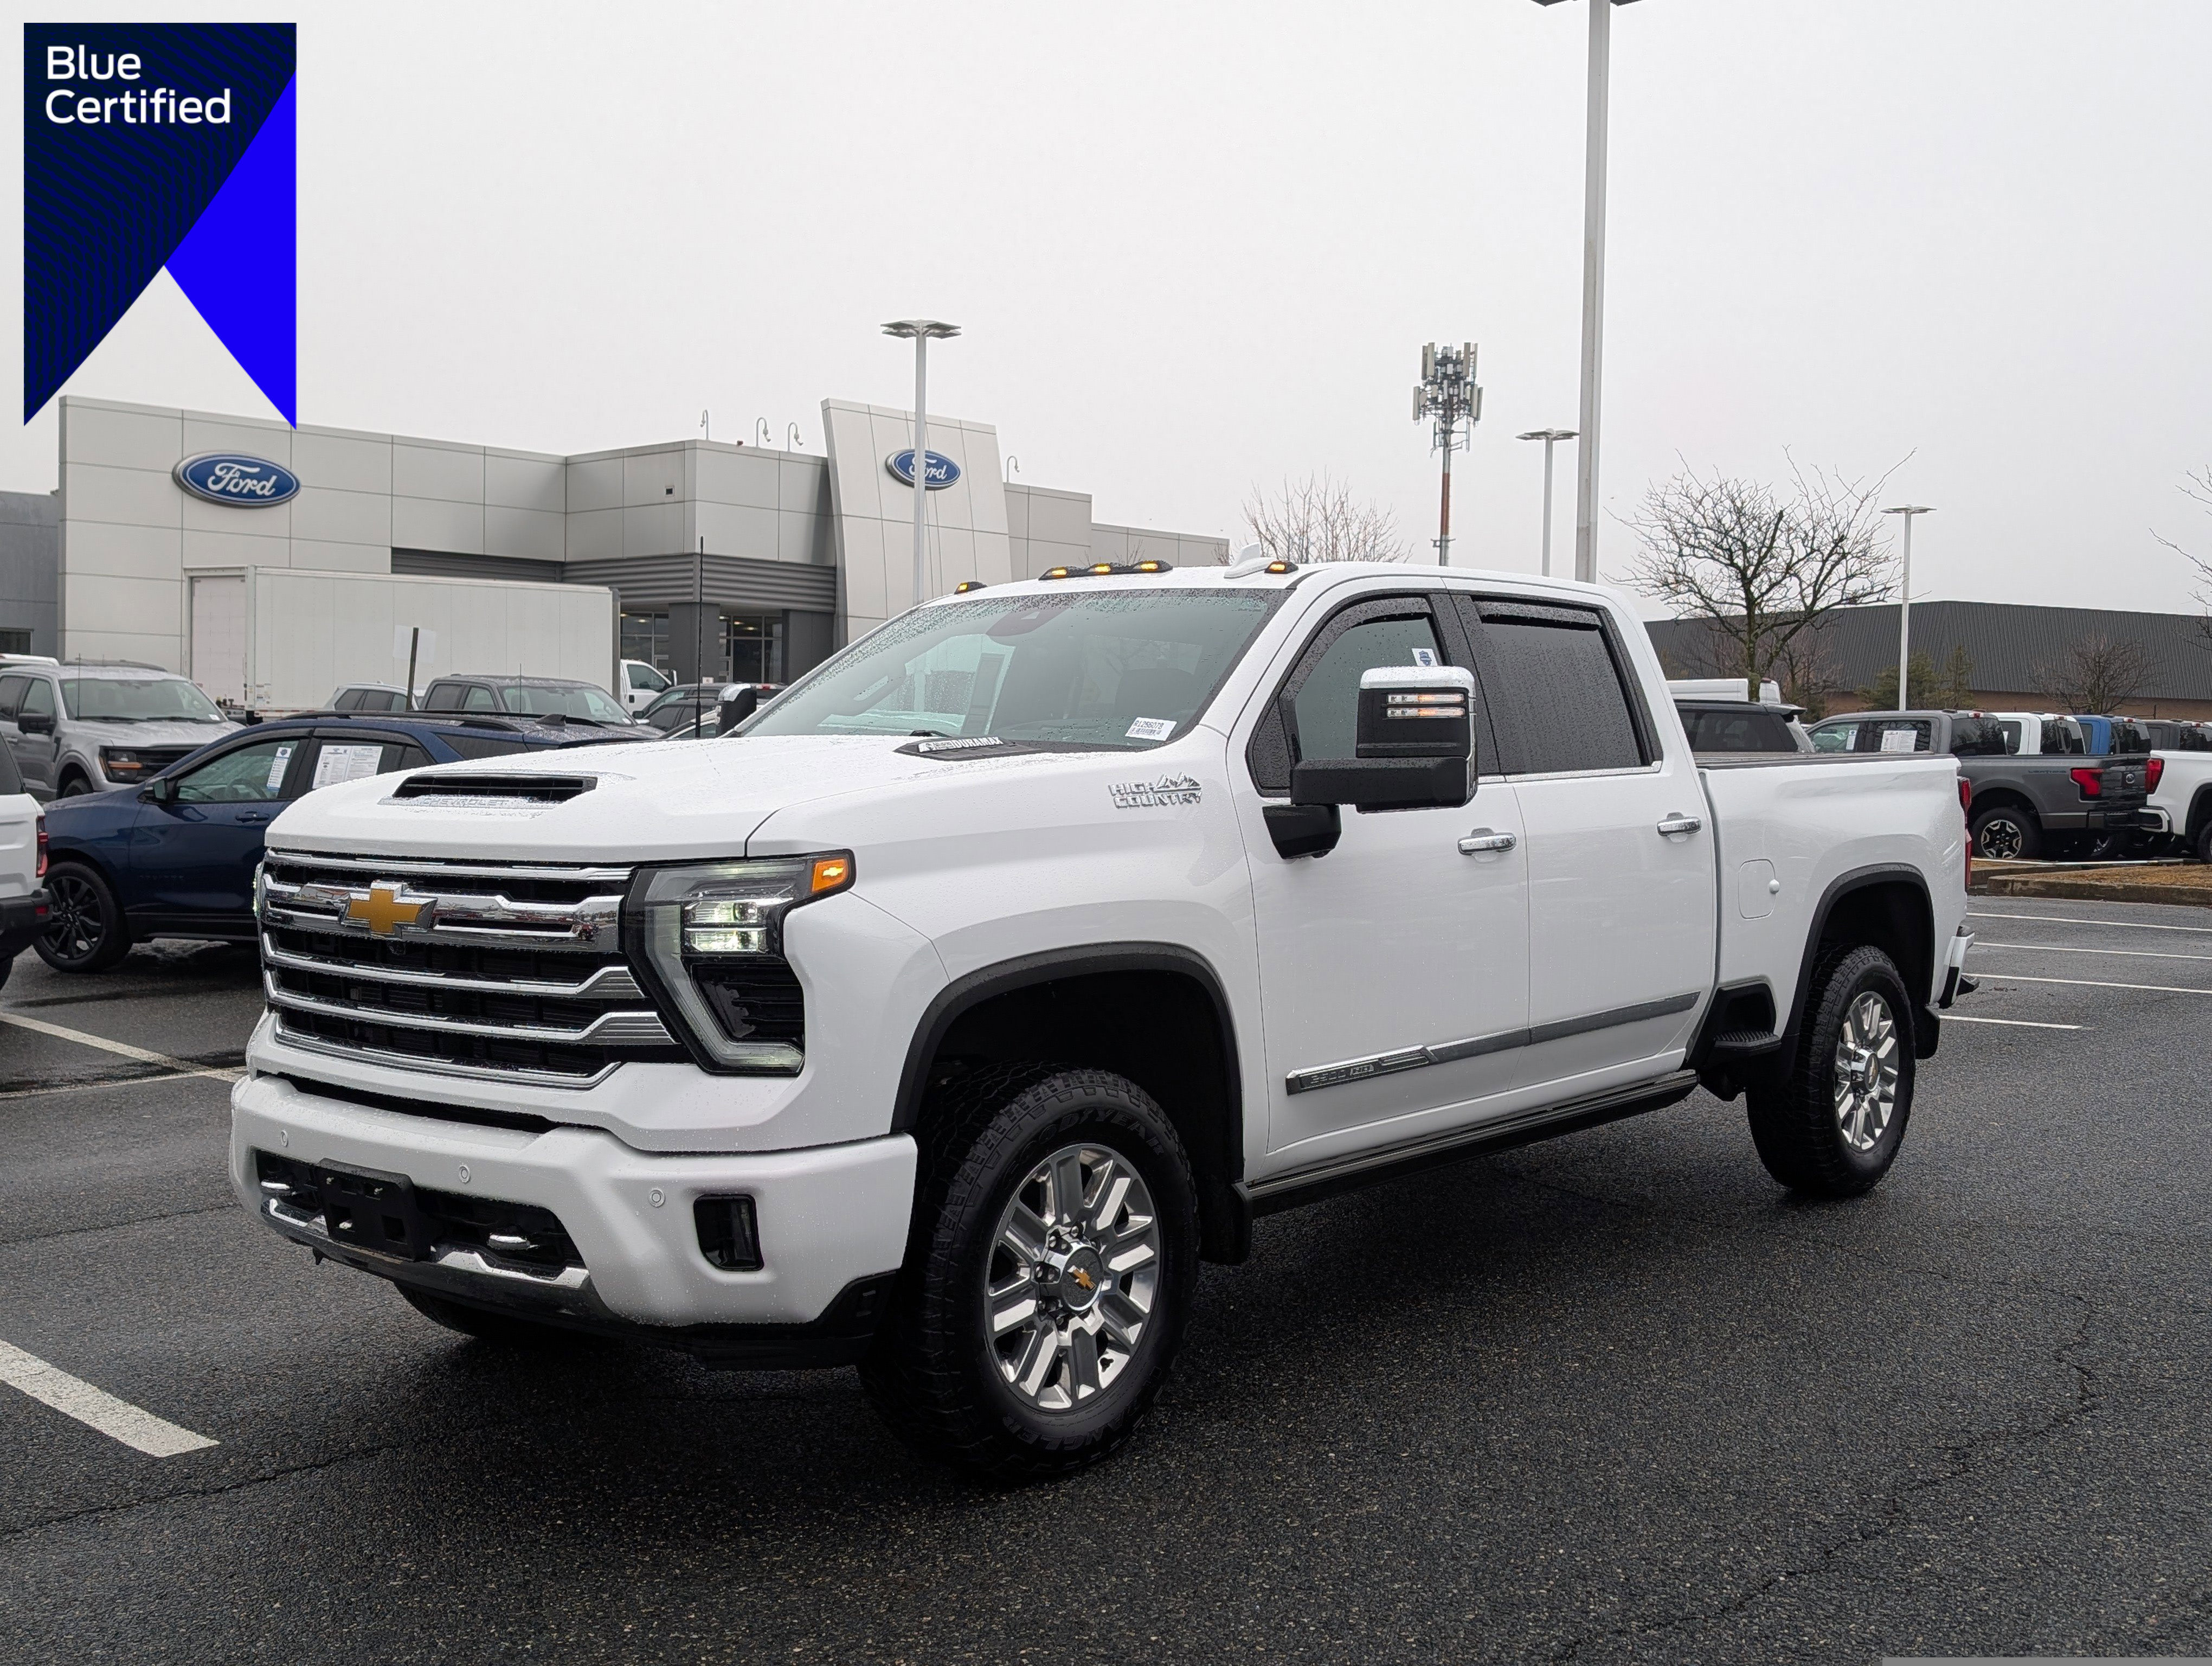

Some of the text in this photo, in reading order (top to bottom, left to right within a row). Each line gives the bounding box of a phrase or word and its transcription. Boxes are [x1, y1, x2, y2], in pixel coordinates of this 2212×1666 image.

[207, 462, 278, 496] Ford
[950, 736, 1004, 748] DURAMAX
[1108, 783, 1156, 796] HIGH
[1114, 792, 1202, 809] COUNTRY
